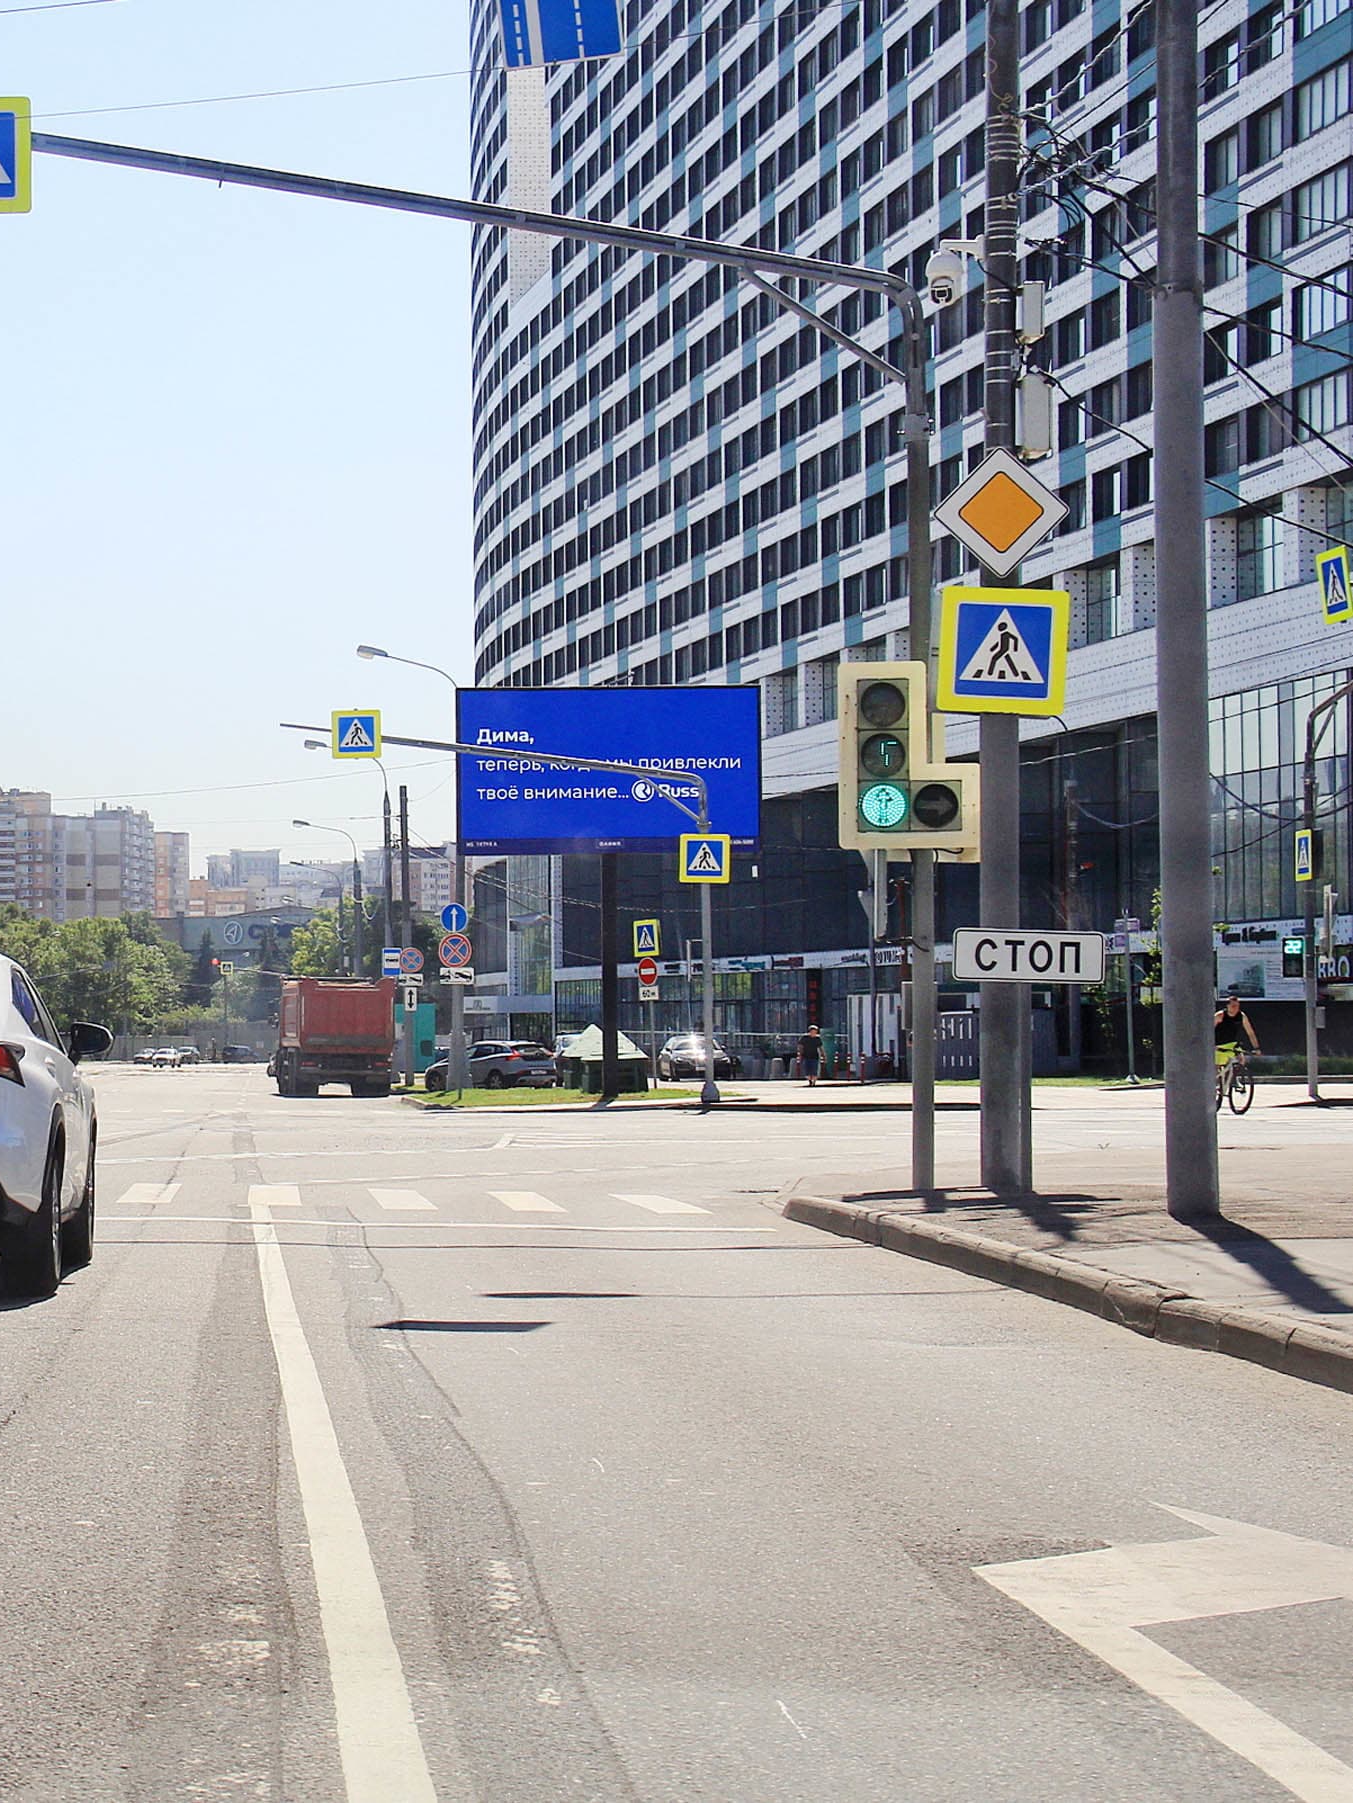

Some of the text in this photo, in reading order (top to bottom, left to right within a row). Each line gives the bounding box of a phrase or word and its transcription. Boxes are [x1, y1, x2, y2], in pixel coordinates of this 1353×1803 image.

[476, 729, 534, 745] Дима,
[476, 759, 545, 773] теперь,
[639, 757, 741, 770] привлекли
[476, 785, 629, 800] твоё внимание...
[658, 783, 700, 798] Russ
[975, 938, 1081, 974] СТОП
